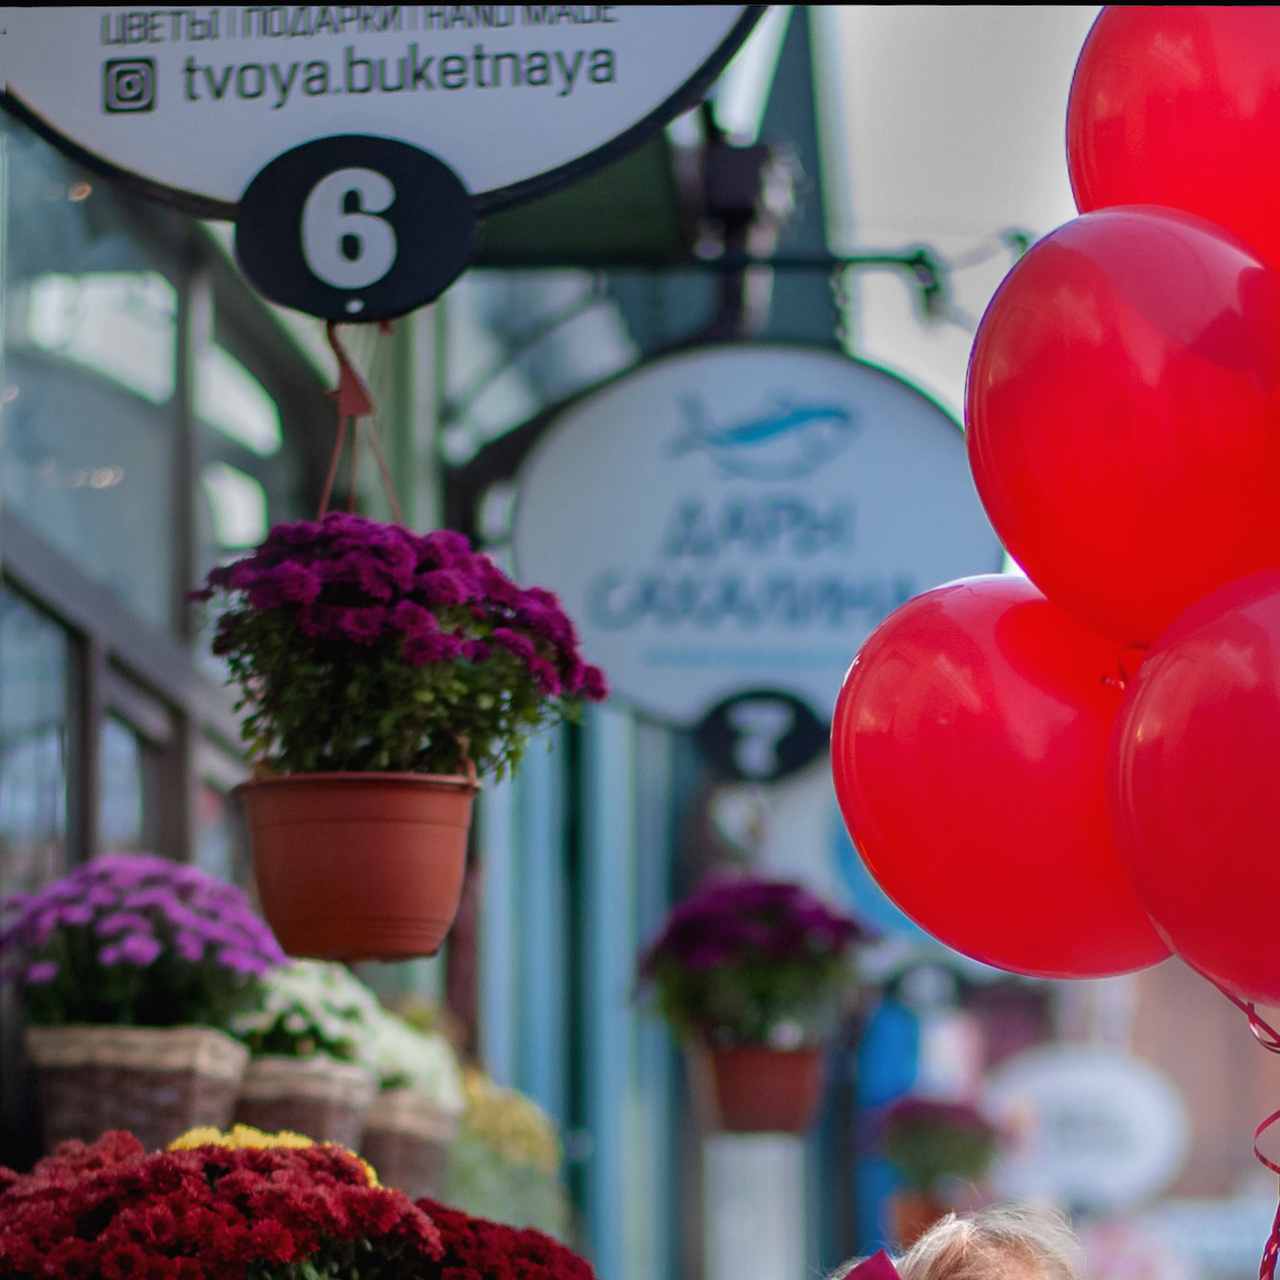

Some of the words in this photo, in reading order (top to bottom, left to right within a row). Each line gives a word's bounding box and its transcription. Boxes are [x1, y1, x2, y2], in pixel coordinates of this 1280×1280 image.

[102, 9, 219, 44] ЦВЕТЫ
[243, 6, 402, 39] ПОДАРКИ
[184, 42, 616, 110] tvoya.buketnaya
[302, 166, 398, 290] 6
[728, 700, 796, 778] 7
